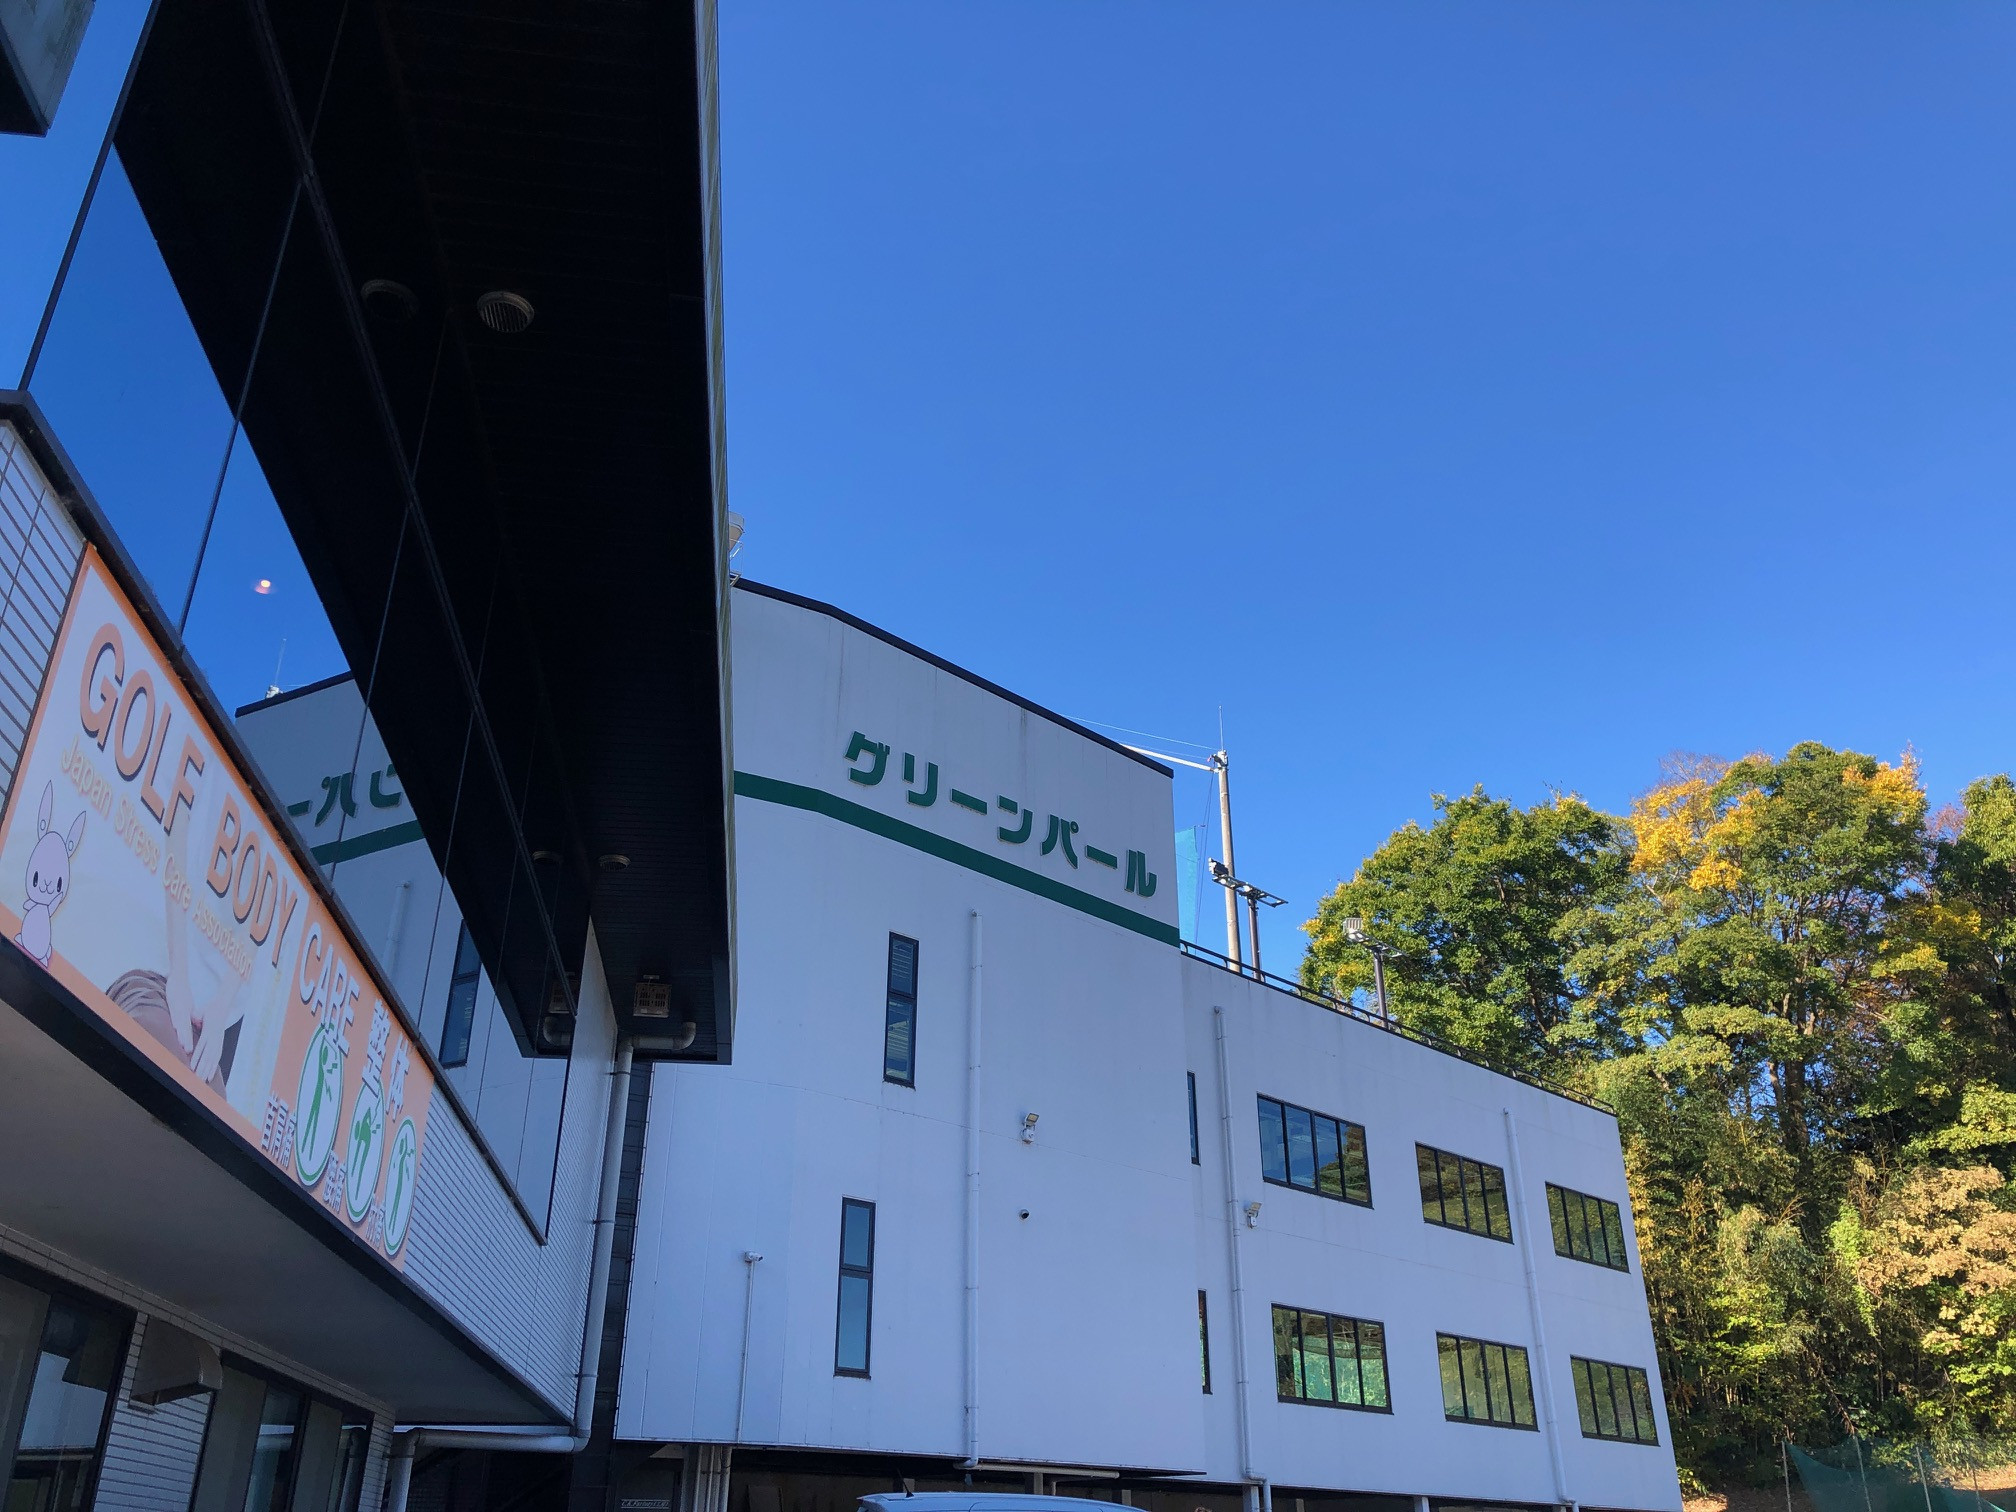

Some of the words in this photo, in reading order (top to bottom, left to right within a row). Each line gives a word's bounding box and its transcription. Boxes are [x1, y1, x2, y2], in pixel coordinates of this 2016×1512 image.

[61, 734, 114, 821] Japan
[114, 791, 162, 875] Stress
[162, 851, 193, 912] Care
[192, 896, 253, 981] Association
[80, 622, 205, 836] GOLF
[206, 791, 298, 969] BODY
[299, 921, 360, 1058] CARE
[843, 730, 1157, 898] グリーンパール
[361, 998, 410, 1124] 整体
